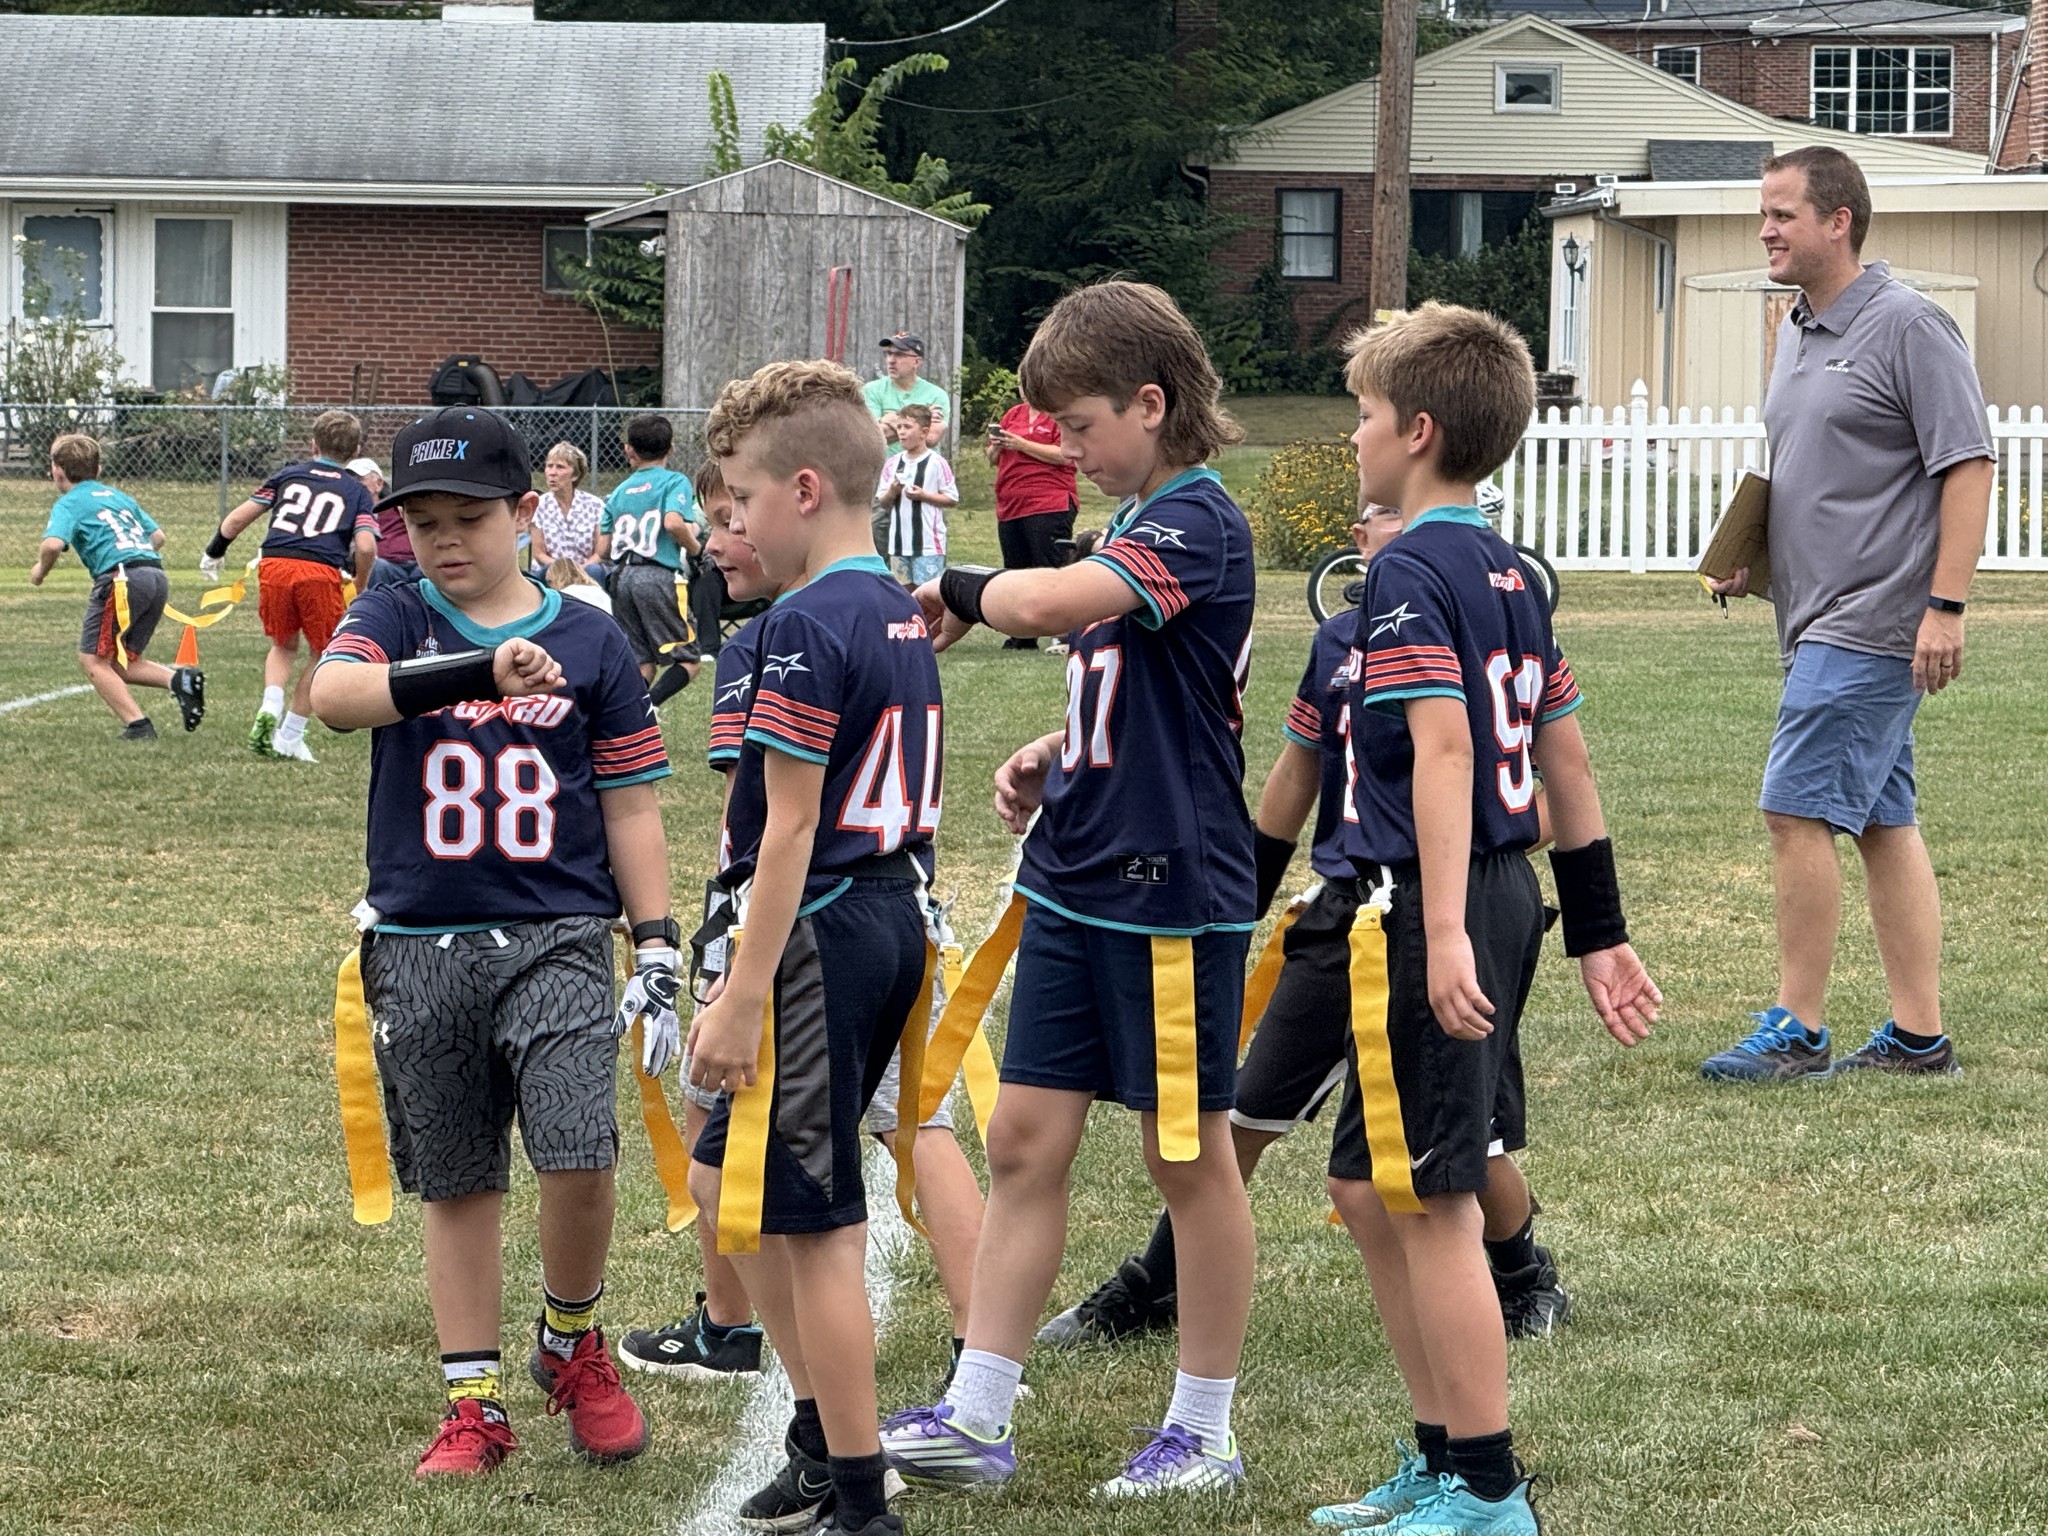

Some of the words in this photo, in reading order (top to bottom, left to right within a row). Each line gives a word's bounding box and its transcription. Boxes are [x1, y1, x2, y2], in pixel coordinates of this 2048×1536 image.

[271, 482, 346, 538] 20
[610, 508, 662, 561] 80
[422, 738, 560, 862] 88
[1152, 866, 1160, 881] L
